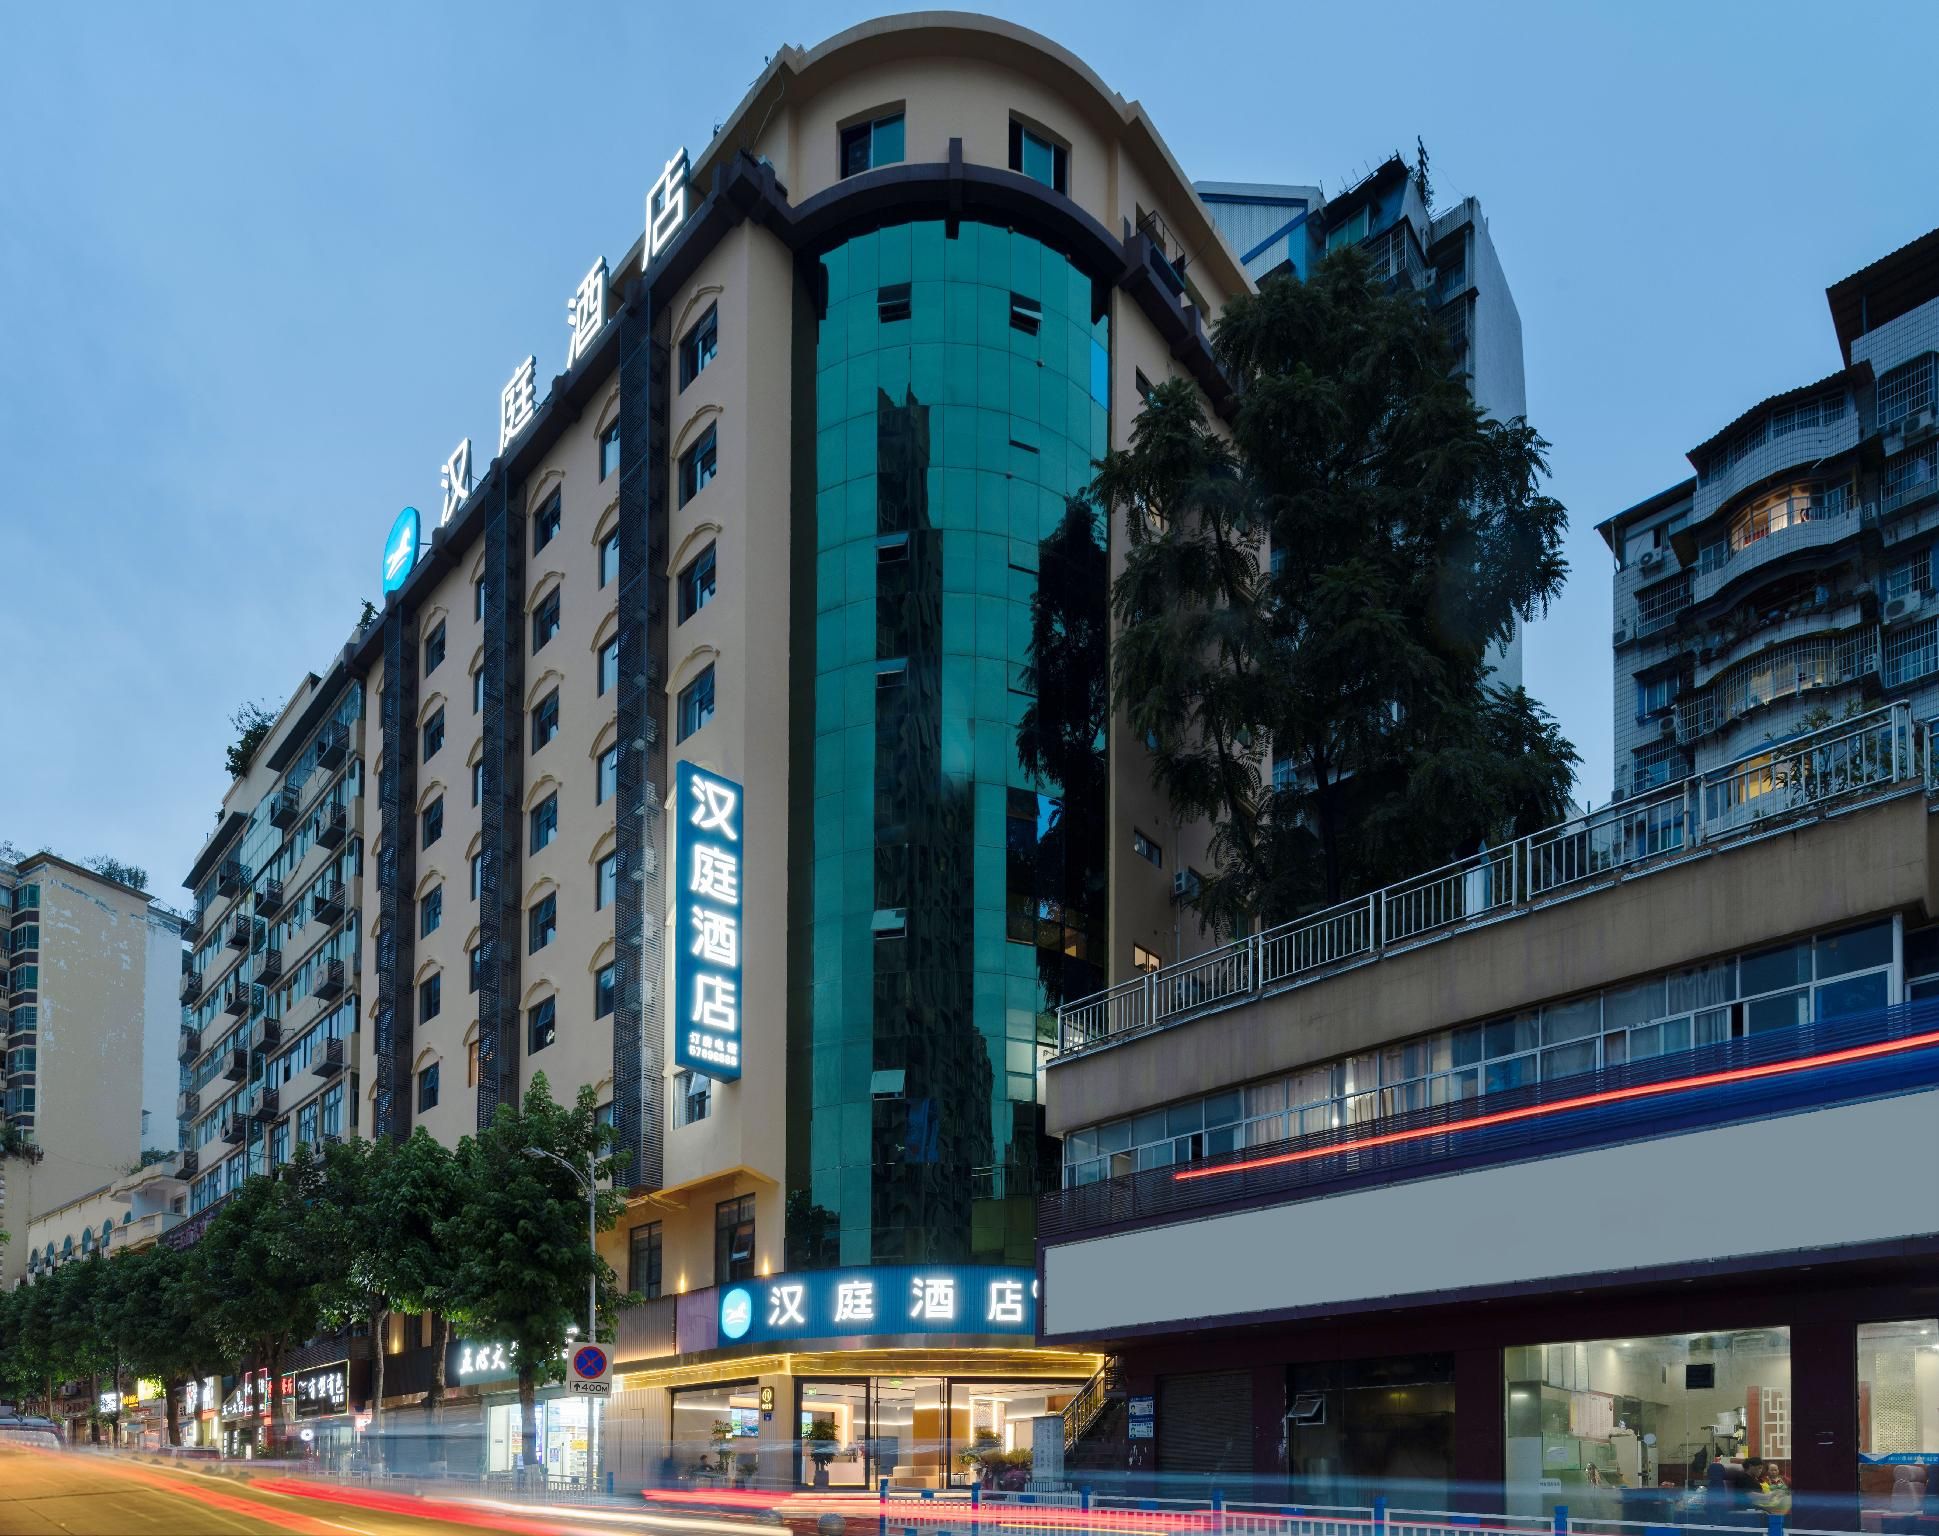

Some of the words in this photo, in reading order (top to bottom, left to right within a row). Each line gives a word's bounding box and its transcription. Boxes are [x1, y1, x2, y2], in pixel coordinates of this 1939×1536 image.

[441, 147, 687, 526] 汉庭酒店
[691, 775, 738, 1032] 汉庭酒店
[769, 1278, 1022, 1325] 汉庭酒店
